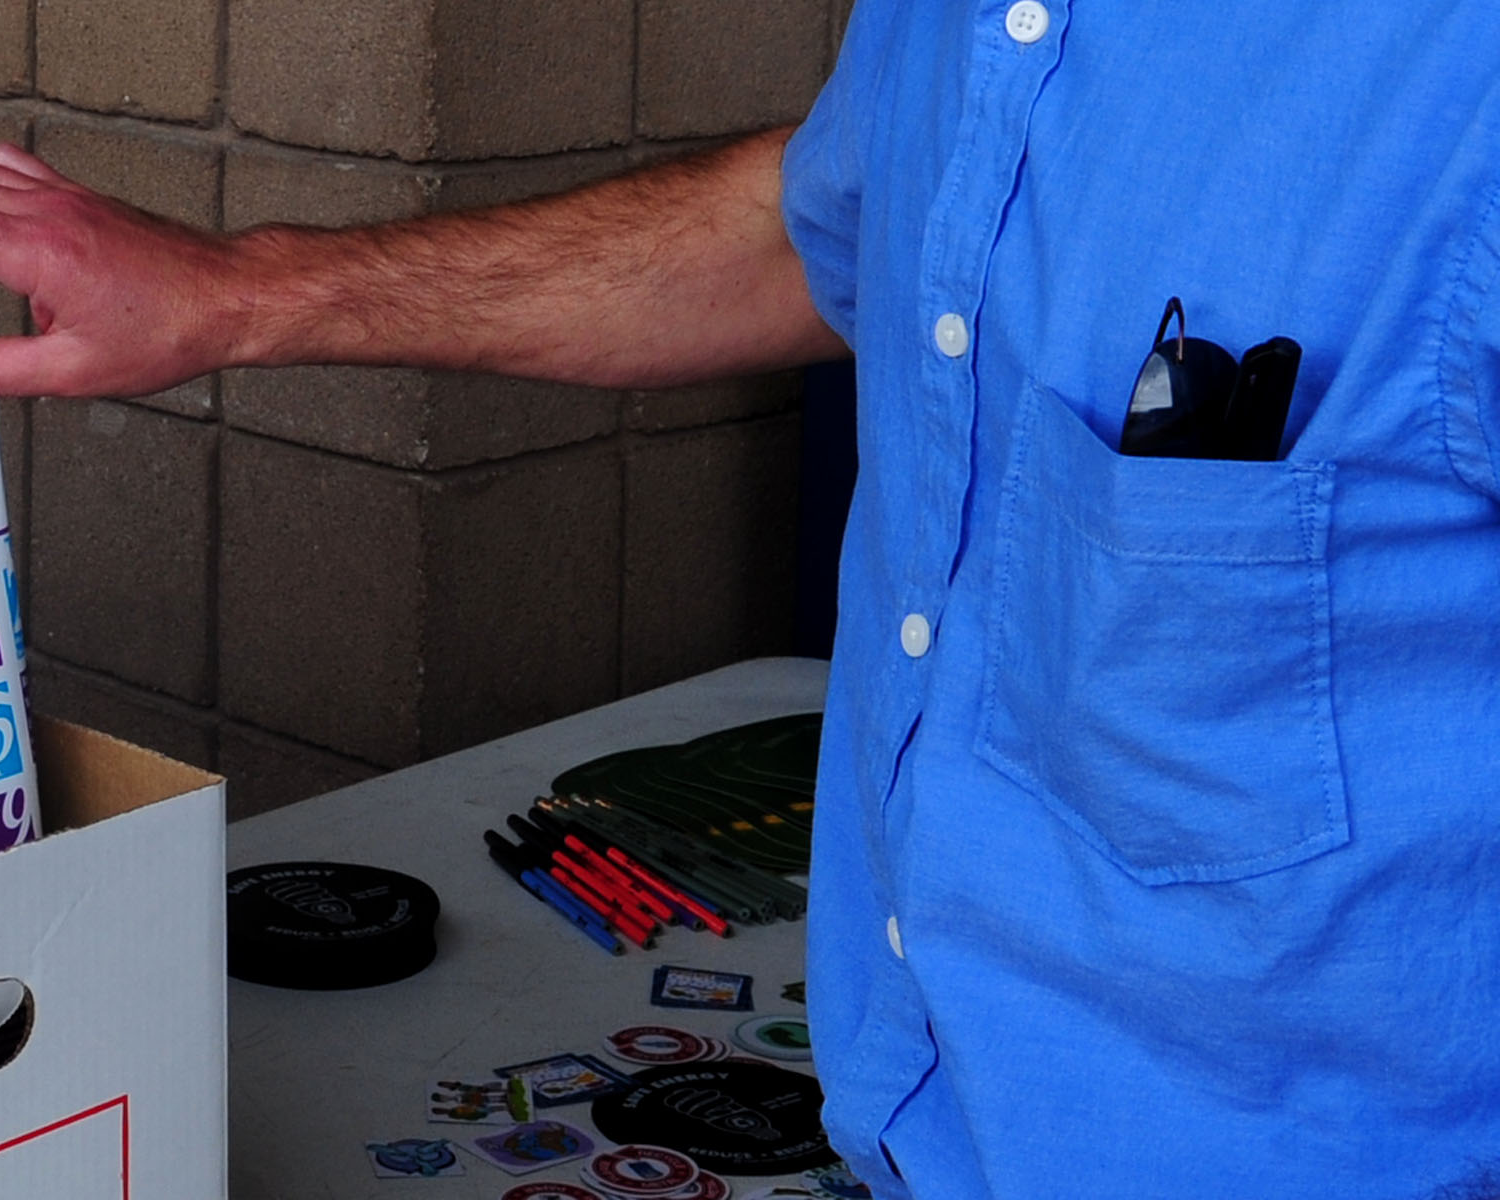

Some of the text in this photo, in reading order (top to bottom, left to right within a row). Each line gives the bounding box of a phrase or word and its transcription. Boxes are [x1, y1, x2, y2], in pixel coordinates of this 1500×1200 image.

[2, 786, 31, 846] 9
[260, 869, 336, 881] ENERGY
[621, 1071, 730, 1108] SAVE ENERGY
[687, 1146, 753, 1160] REDUCE
